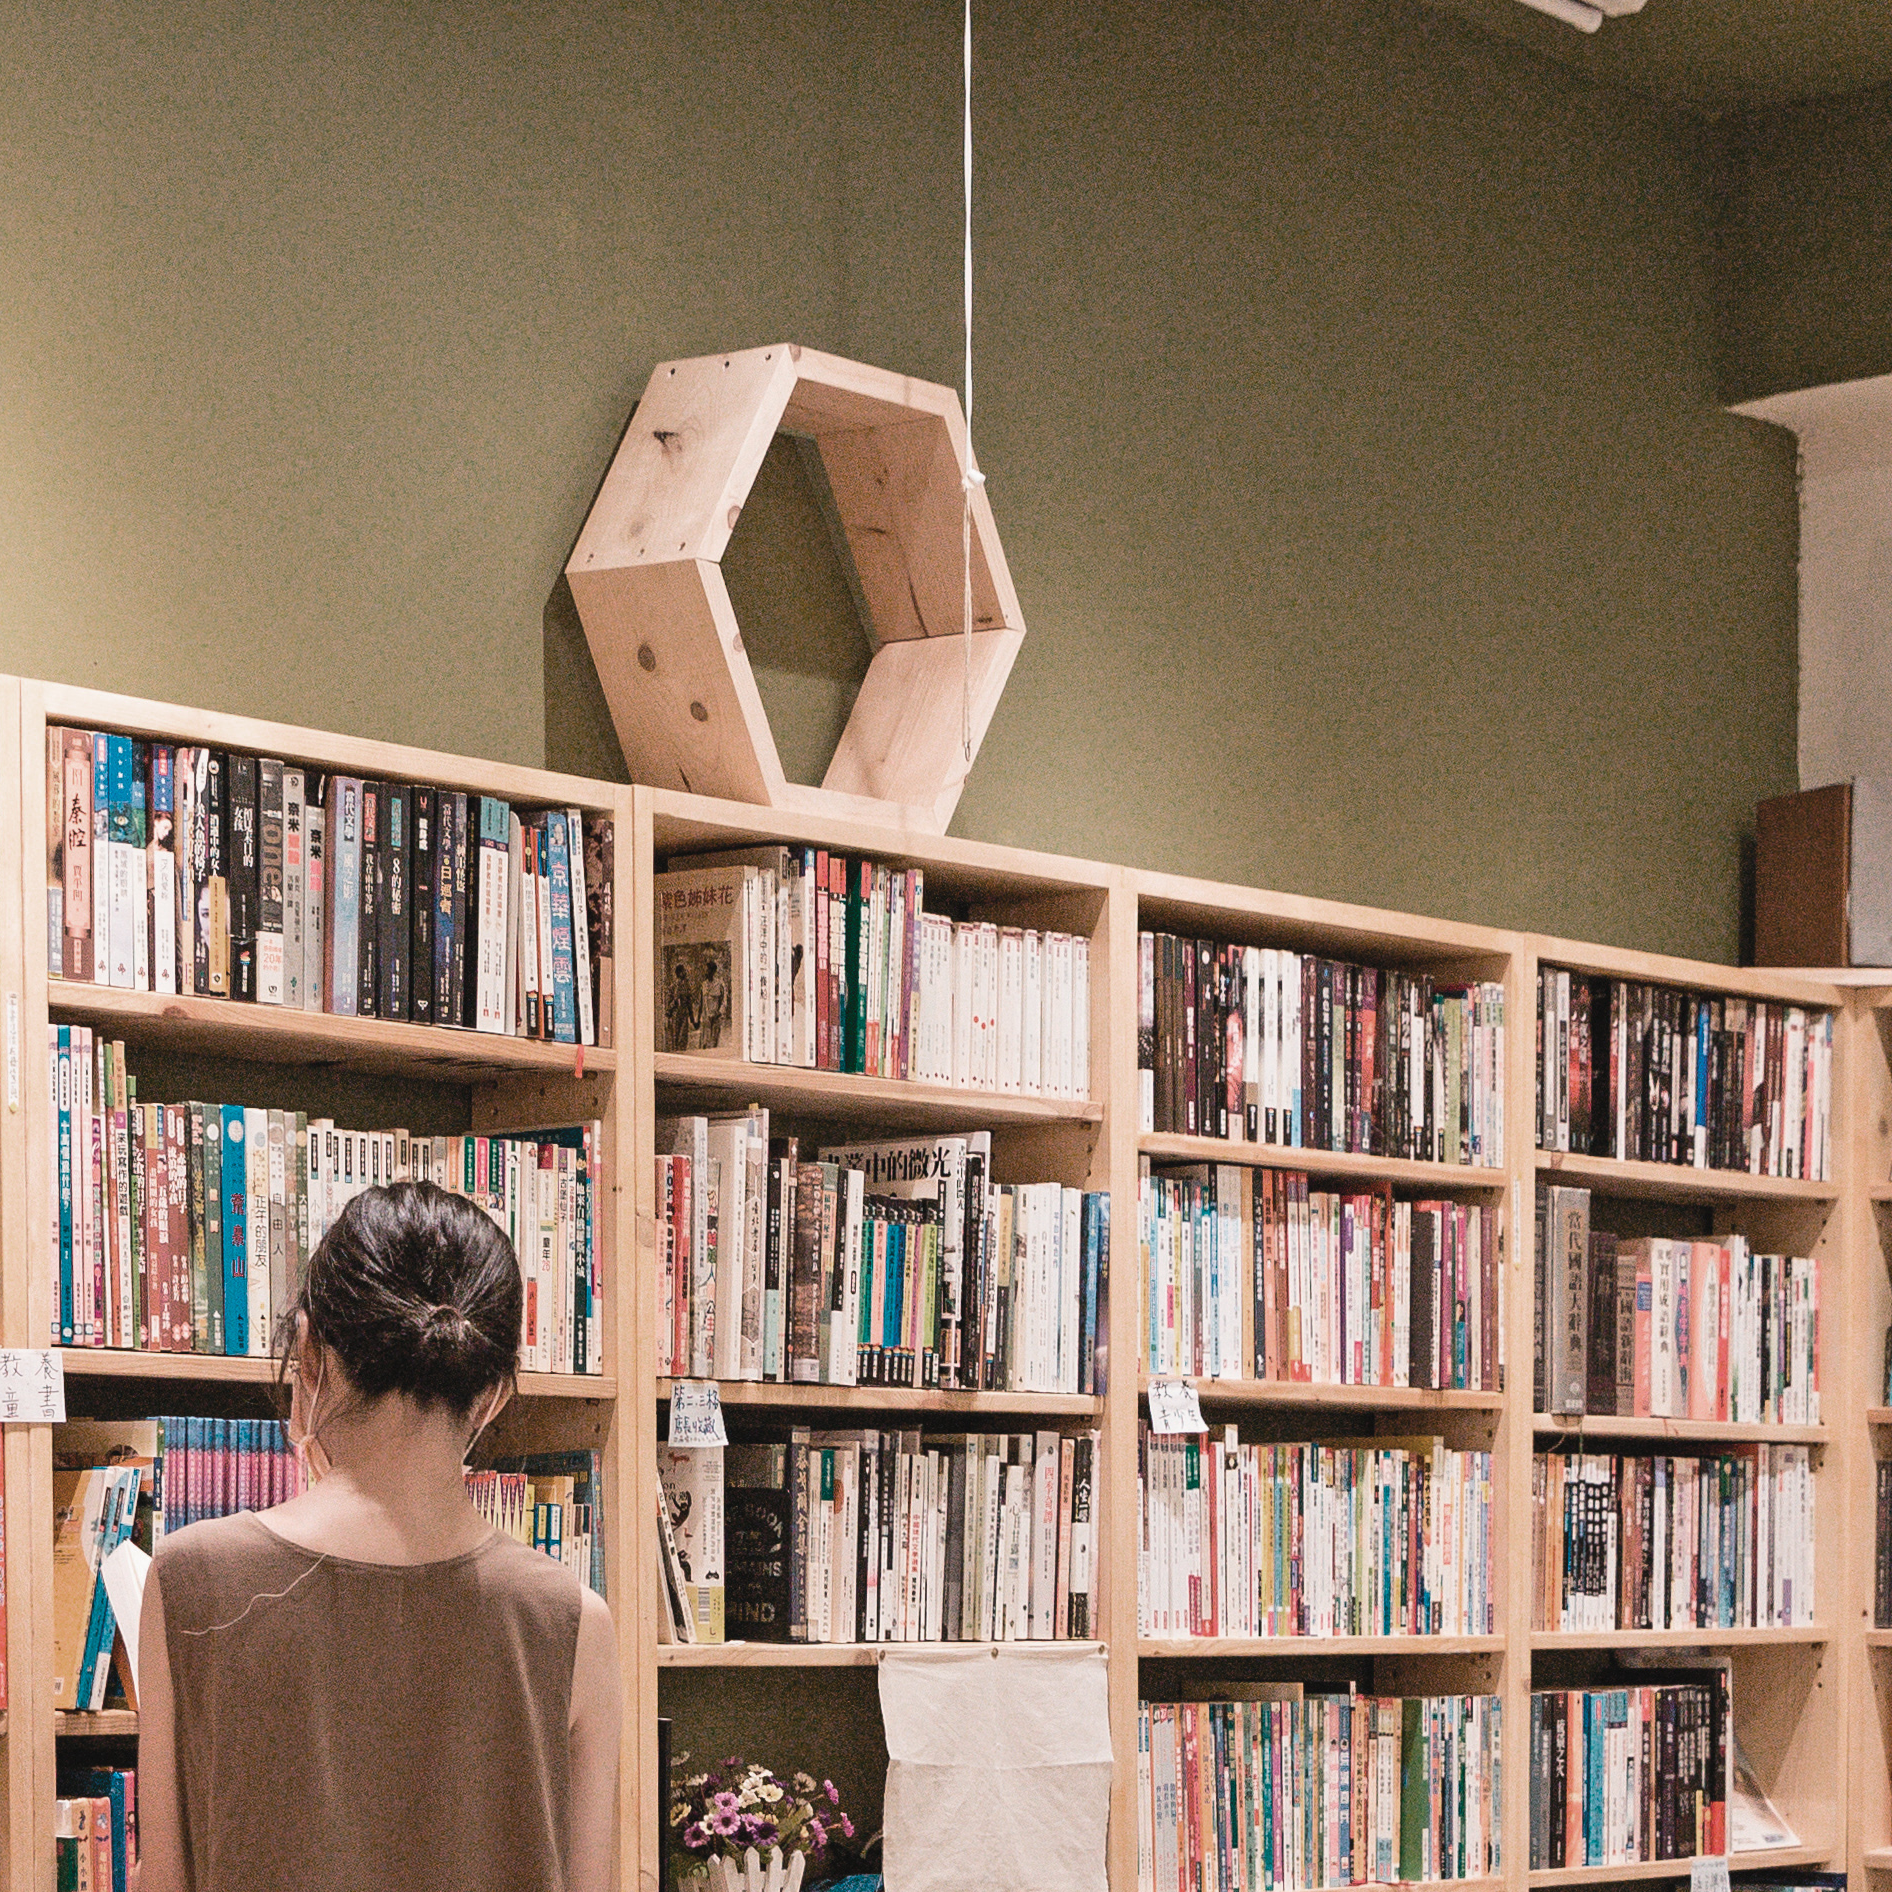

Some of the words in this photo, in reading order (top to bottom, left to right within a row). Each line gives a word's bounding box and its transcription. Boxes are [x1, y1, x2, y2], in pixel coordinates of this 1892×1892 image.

[68, 796, 87, 850] 秦腔
[827, 1146, 952, 1184] 中的微光
[1566, 1209, 1583, 1355] 當代國語大辭典
[0, 1352, 59, 1380] 教養
